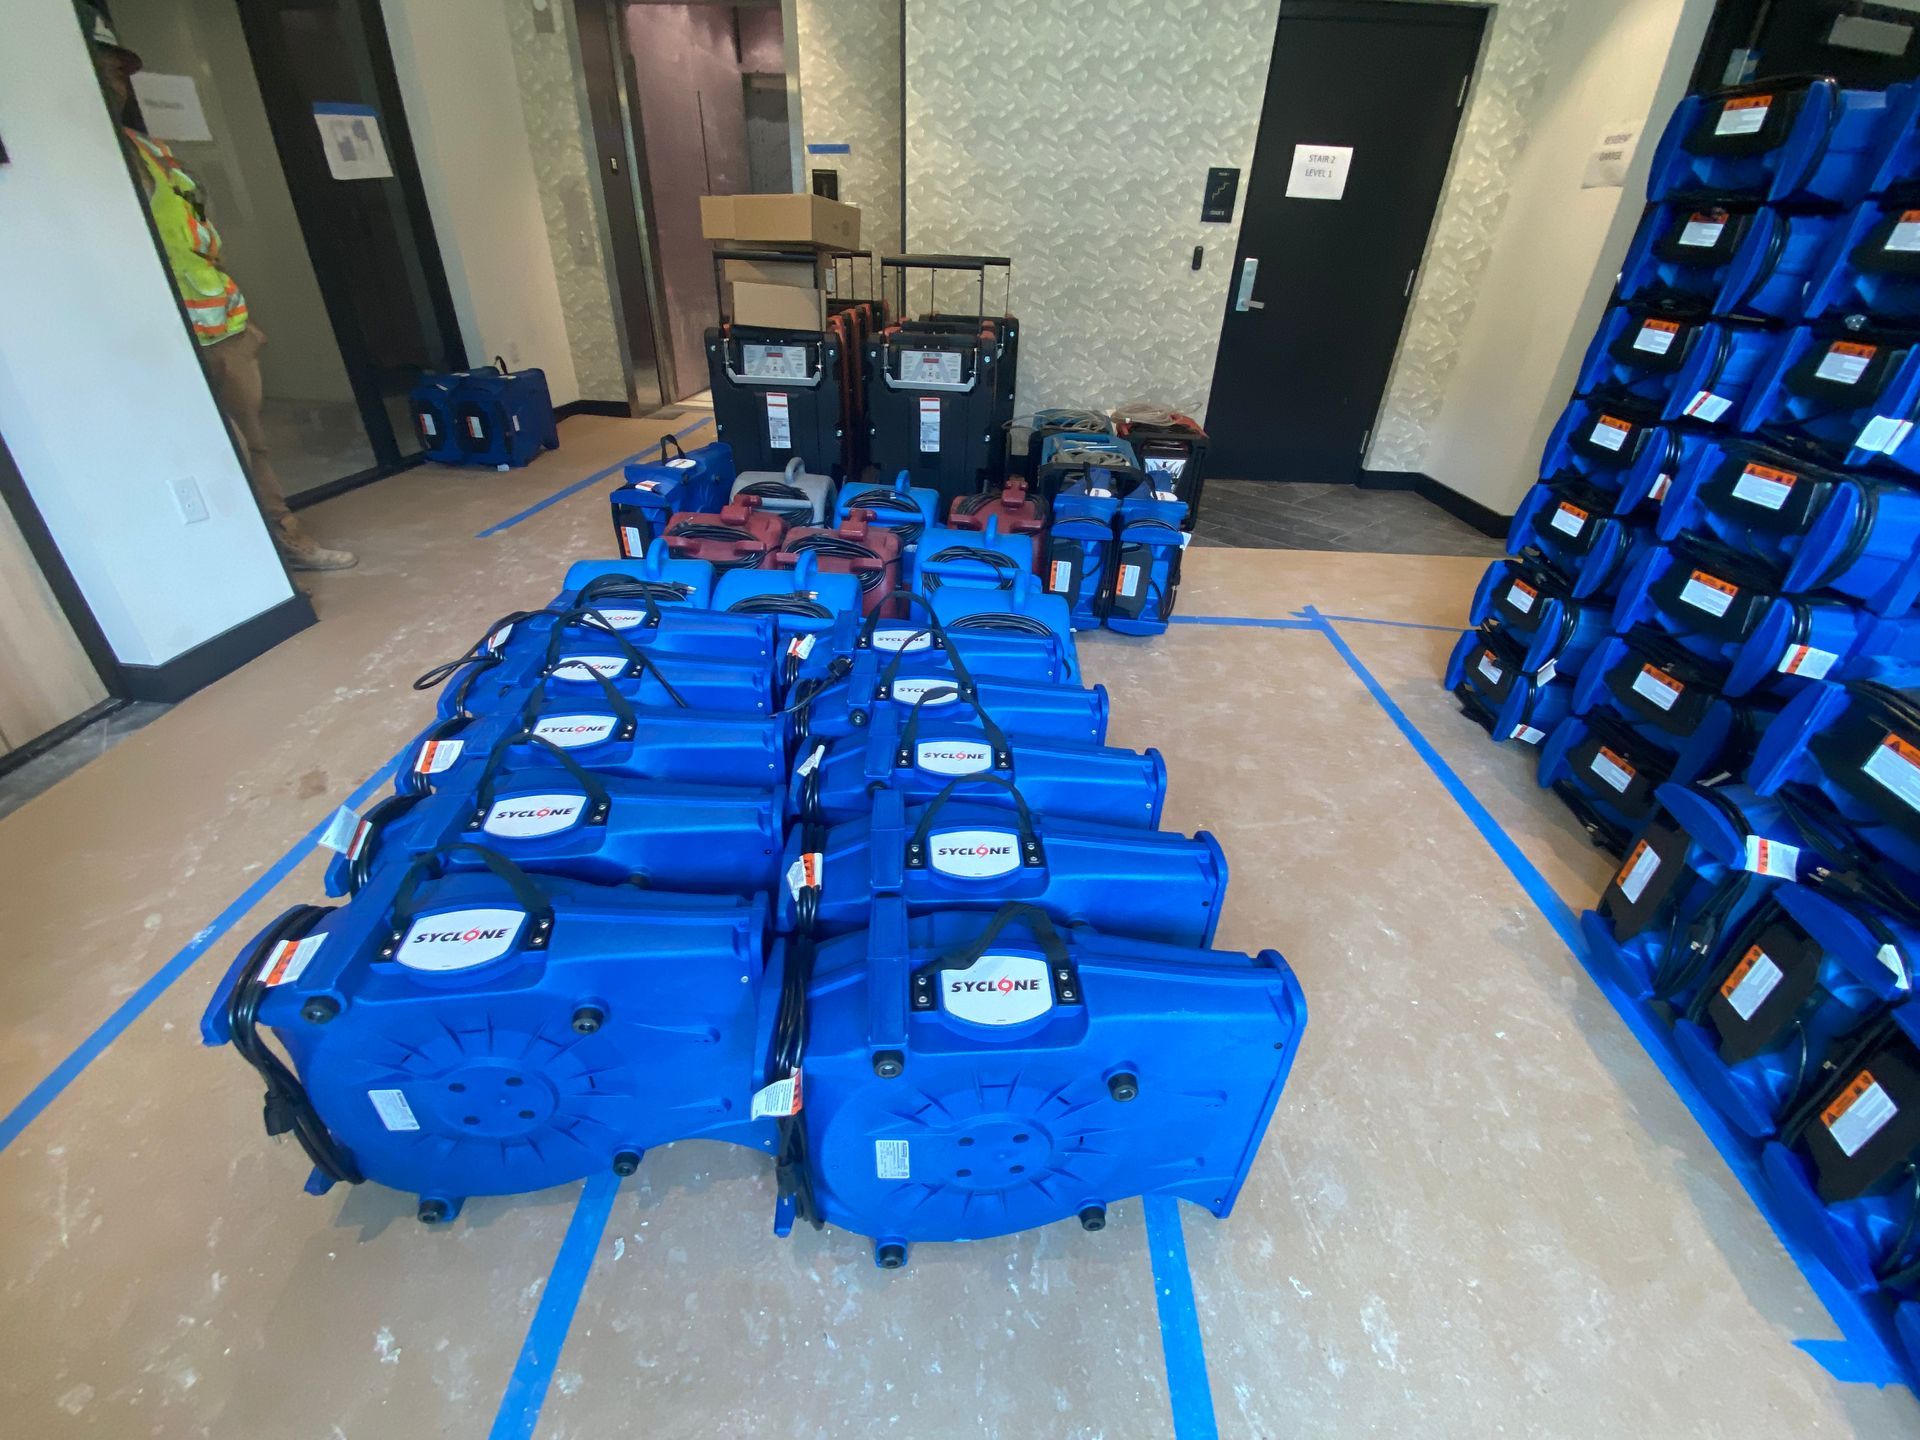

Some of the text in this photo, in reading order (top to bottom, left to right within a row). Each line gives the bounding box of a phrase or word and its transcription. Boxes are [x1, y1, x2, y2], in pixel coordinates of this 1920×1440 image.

[1309, 154, 1336, 164] STAIR 2
[1305, 169, 1325, 177] LEVEL
[540, 725, 606, 733] SYCLONE
[923, 751, 985, 760] SYCLONE
[495, 807, 575, 820] SYCLONE
[938, 844, 1011, 858] SYCLONE
[413, 927, 510, 944] SYCLONE
[951, 976, 1040, 996] SYCLONE
